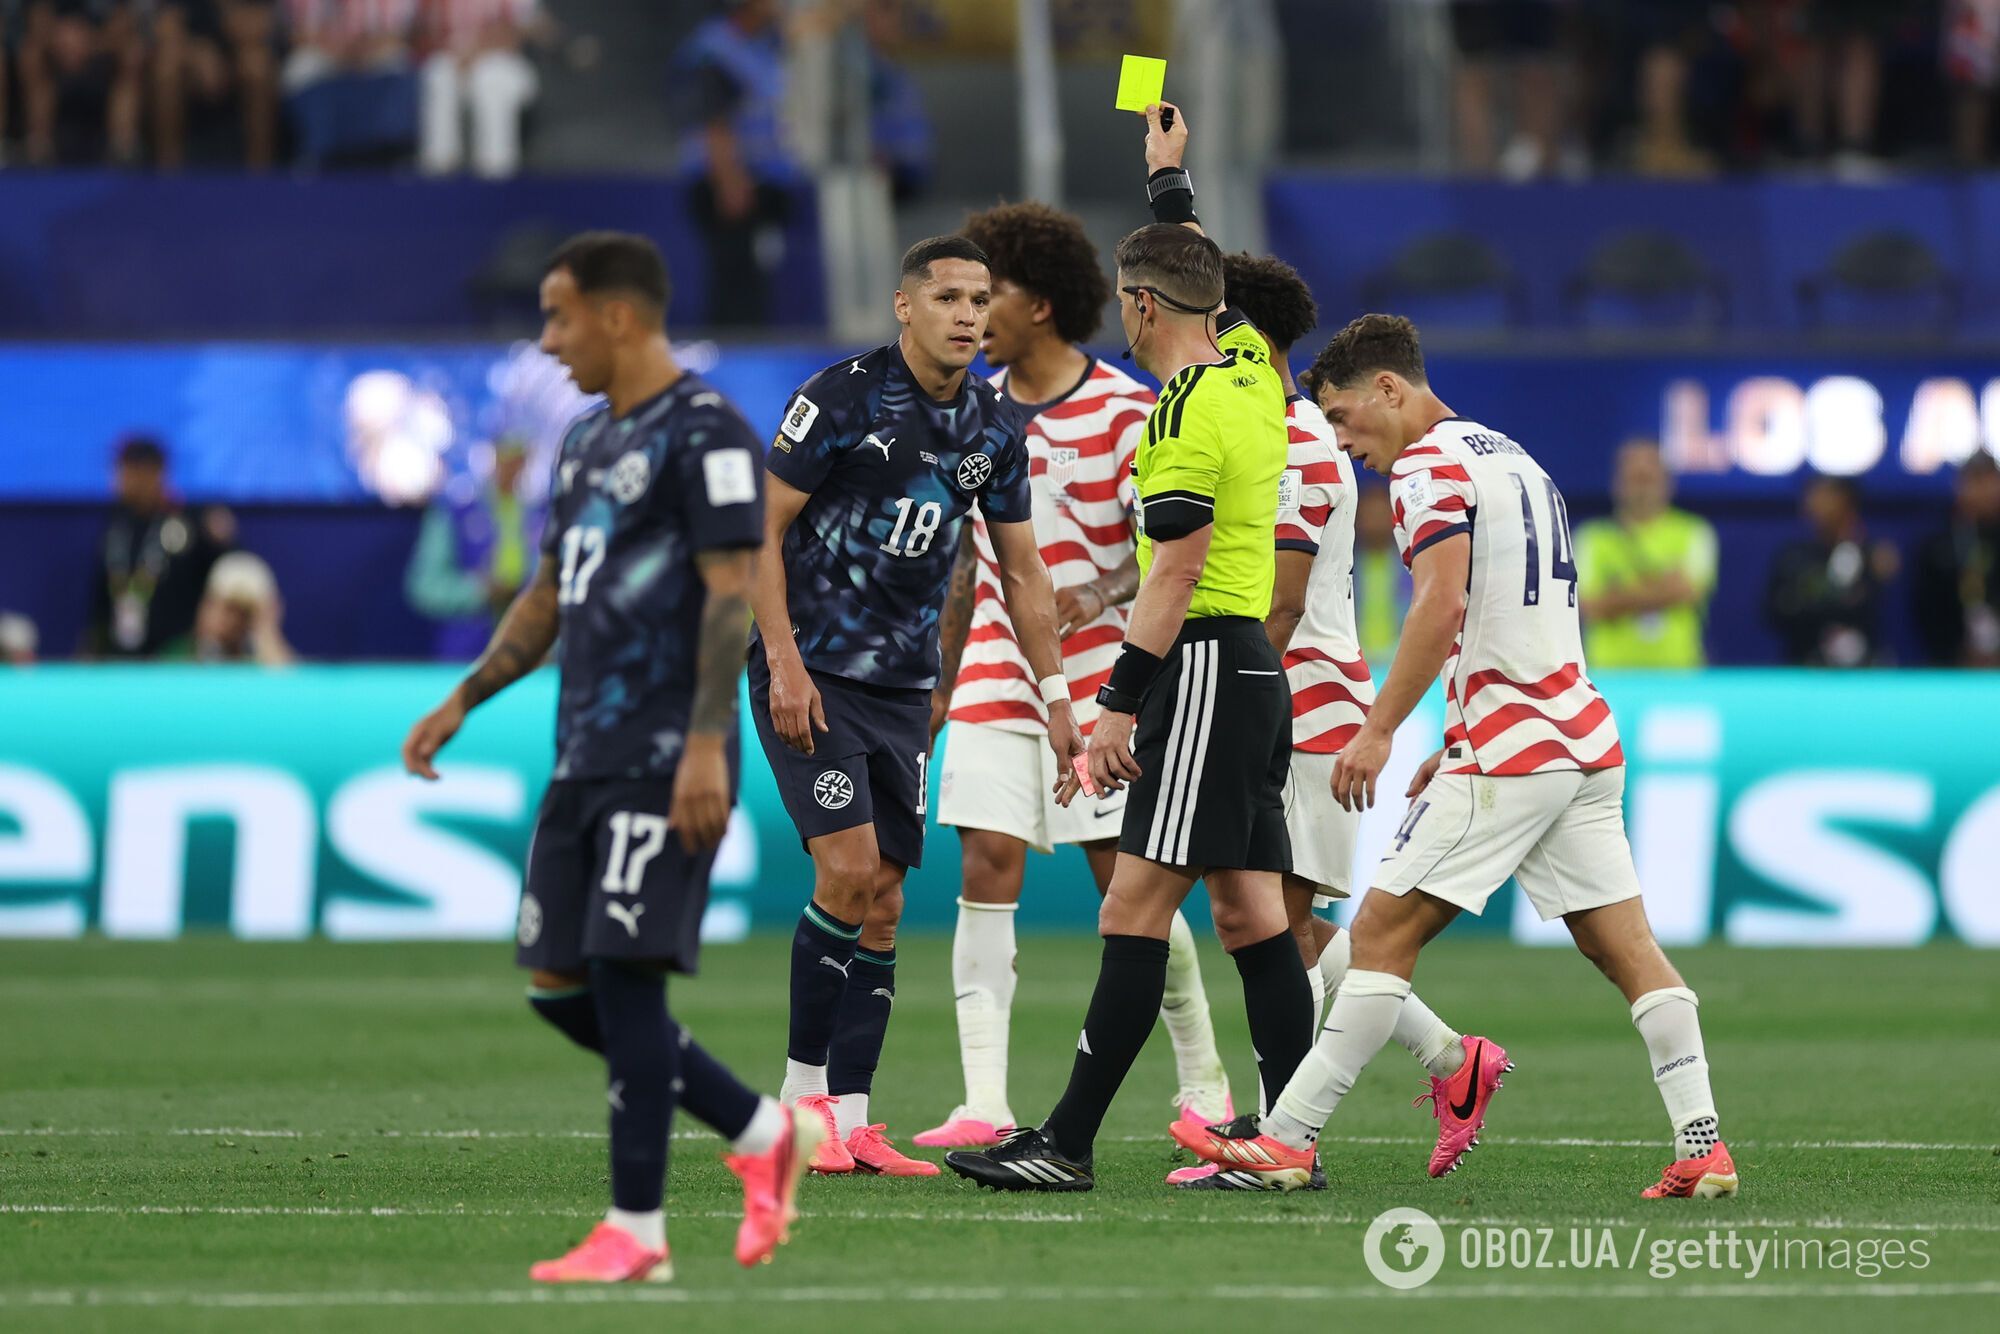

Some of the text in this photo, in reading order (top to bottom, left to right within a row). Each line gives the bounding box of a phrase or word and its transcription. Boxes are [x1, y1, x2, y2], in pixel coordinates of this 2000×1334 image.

[1051, 450, 1076, 465] USA
[879, 497, 942, 557] 18
[1507, 472, 1578, 608] 14
[557, 525, 607, 606] 17
[823, 773, 836, 783] APF
[600, 810, 669, 895] 17
